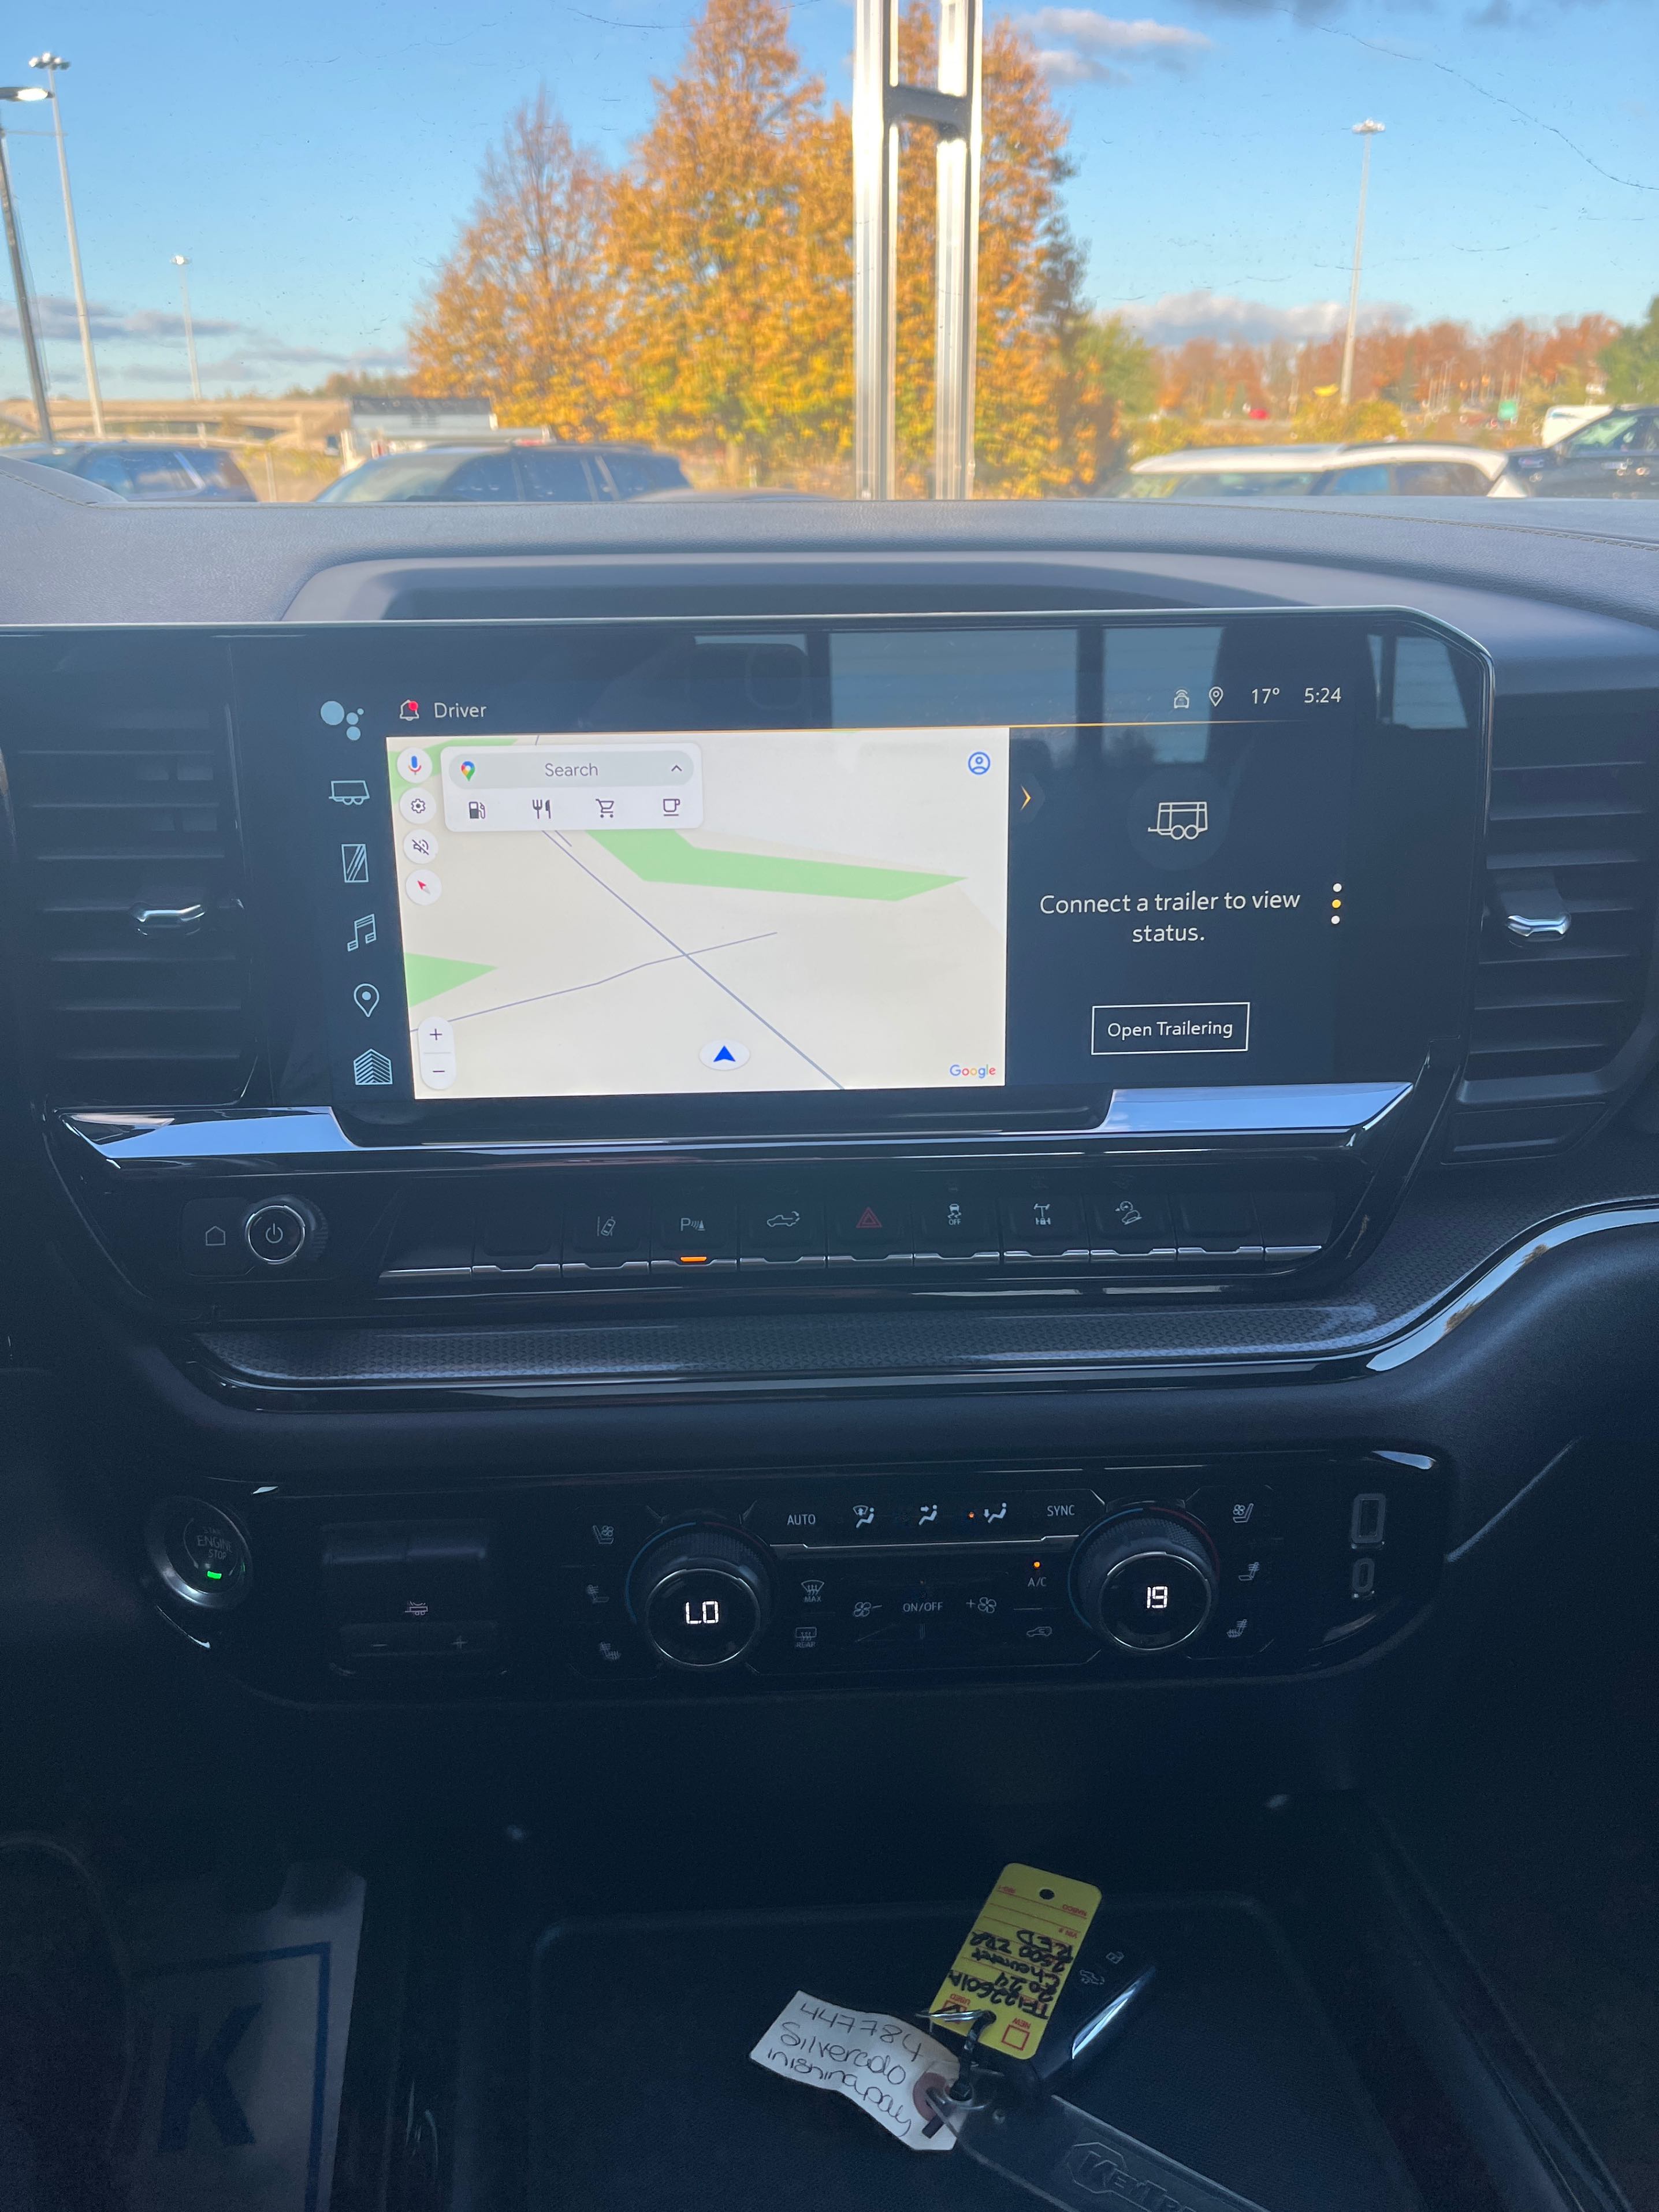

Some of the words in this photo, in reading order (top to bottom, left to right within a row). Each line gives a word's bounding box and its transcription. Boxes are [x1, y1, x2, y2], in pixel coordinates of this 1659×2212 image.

[1251, 687, 1280, 704] 17°
[1304, 687, 1341, 703] 5:24
[434, 701, 486, 718] Driver
[544, 762, 598, 777] Search
[1040, 893, 1130, 914] Connect
[1136, 899, 1149, 912] a
[1154, 891, 1218, 911] trailer
[1223, 893, 1246, 910] to
[1251, 891, 1301, 908] view
[1132, 924, 1205, 943] status.
[1107, 1022, 1152, 1041] Open
[1156, 1021, 1234, 1039] Trailering
[950, 1064, 996, 1078] Google
[680, 1217, 691, 1231] P
[1047, 1505, 1075, 1517] SYNC
[787, 1514, 816, 1525] AUTO
[197, 1535, 232, 1552] ENGINE
[209, 1549, 226, 1559] STOP
[1028, 1577, 1047, 1587] A/C
[1147, 1586, 1168, 1608] 19
[685, 1600, 719, 1624] LO
[903, 1602, 943, 1612] ON/OFF
[1017, 1930, 1073, 1958] RED
[995, 1972, 1058, 2002] 2024
[949, 1993, 971, 2006] USED
[1012, 2017, 1032, 2029] NEW
[800, 2002, 923, 2062] 447784
